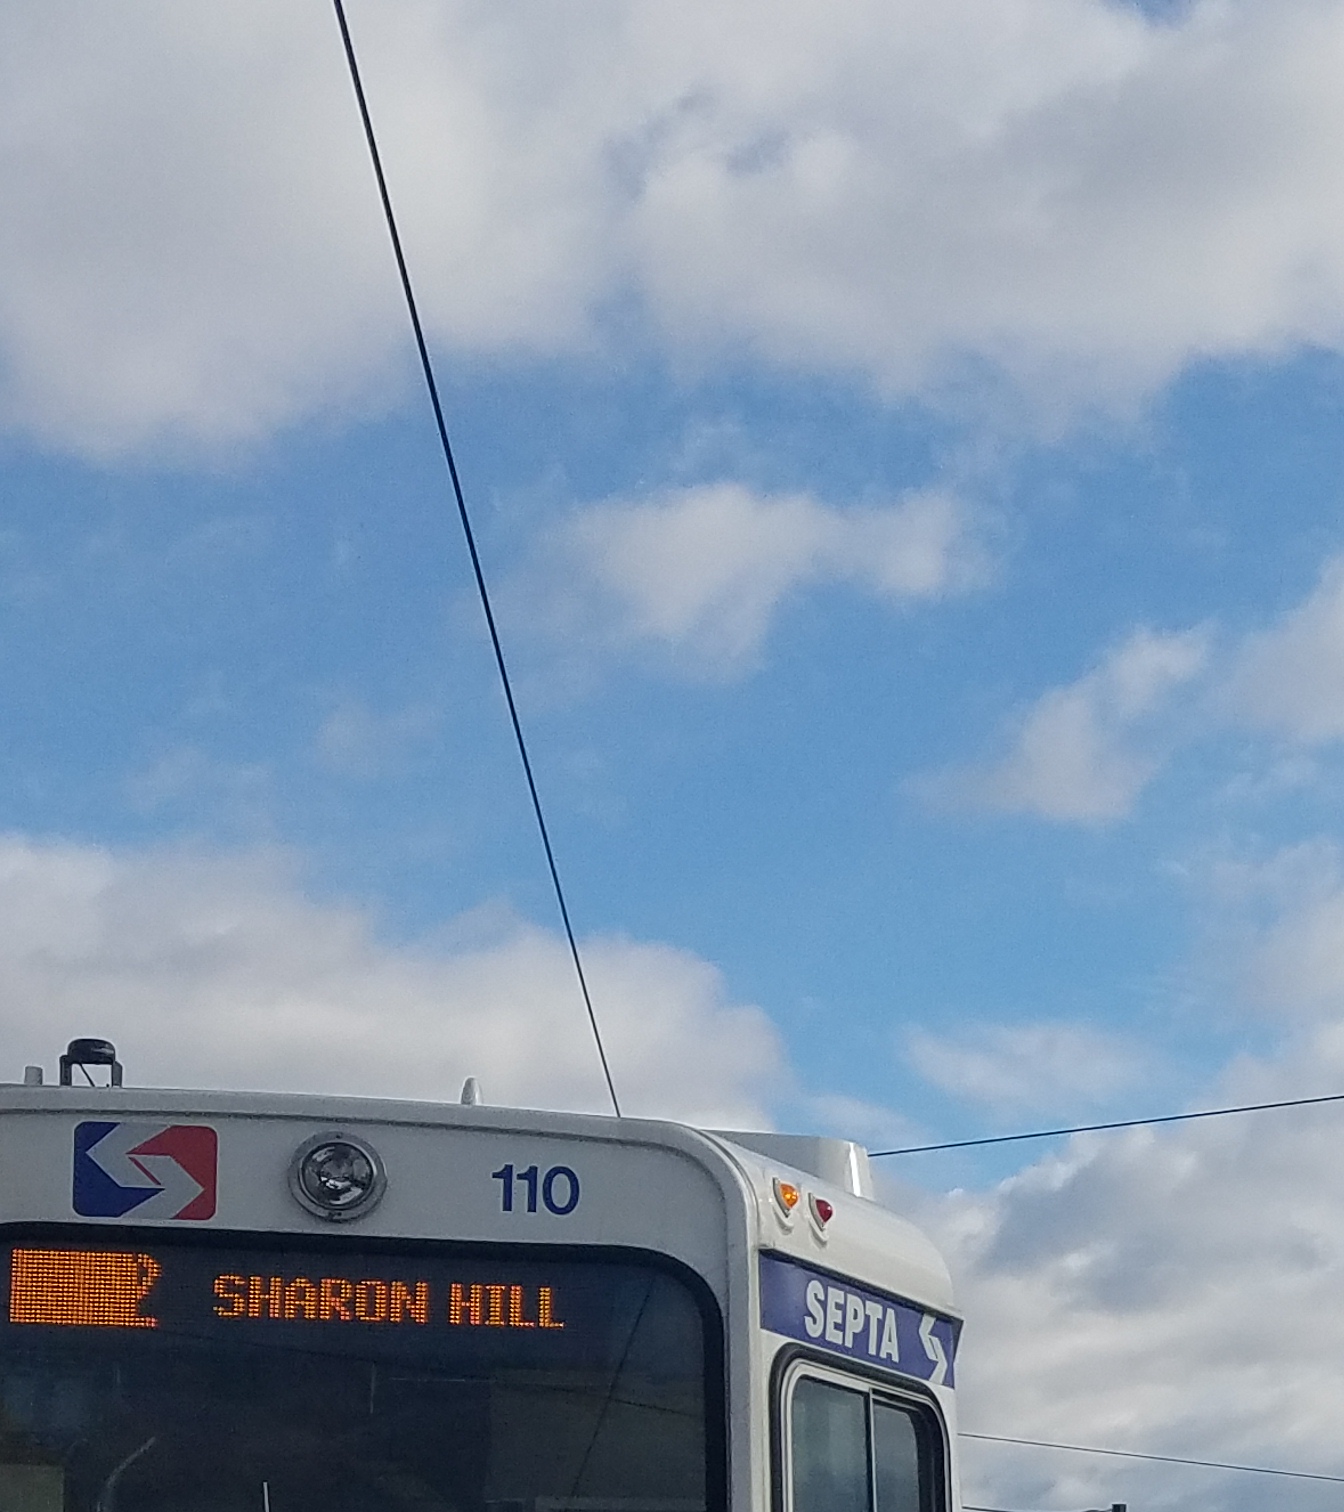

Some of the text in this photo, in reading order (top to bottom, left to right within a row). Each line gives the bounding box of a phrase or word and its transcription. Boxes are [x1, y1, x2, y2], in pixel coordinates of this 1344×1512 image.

[491, 1164, 580, 1215] 110
[213, 1275, 429, 1324] SHARON
[449, 1283, 566, 1328] HILL
[804, 1279, 899, 1363] SEPTA
